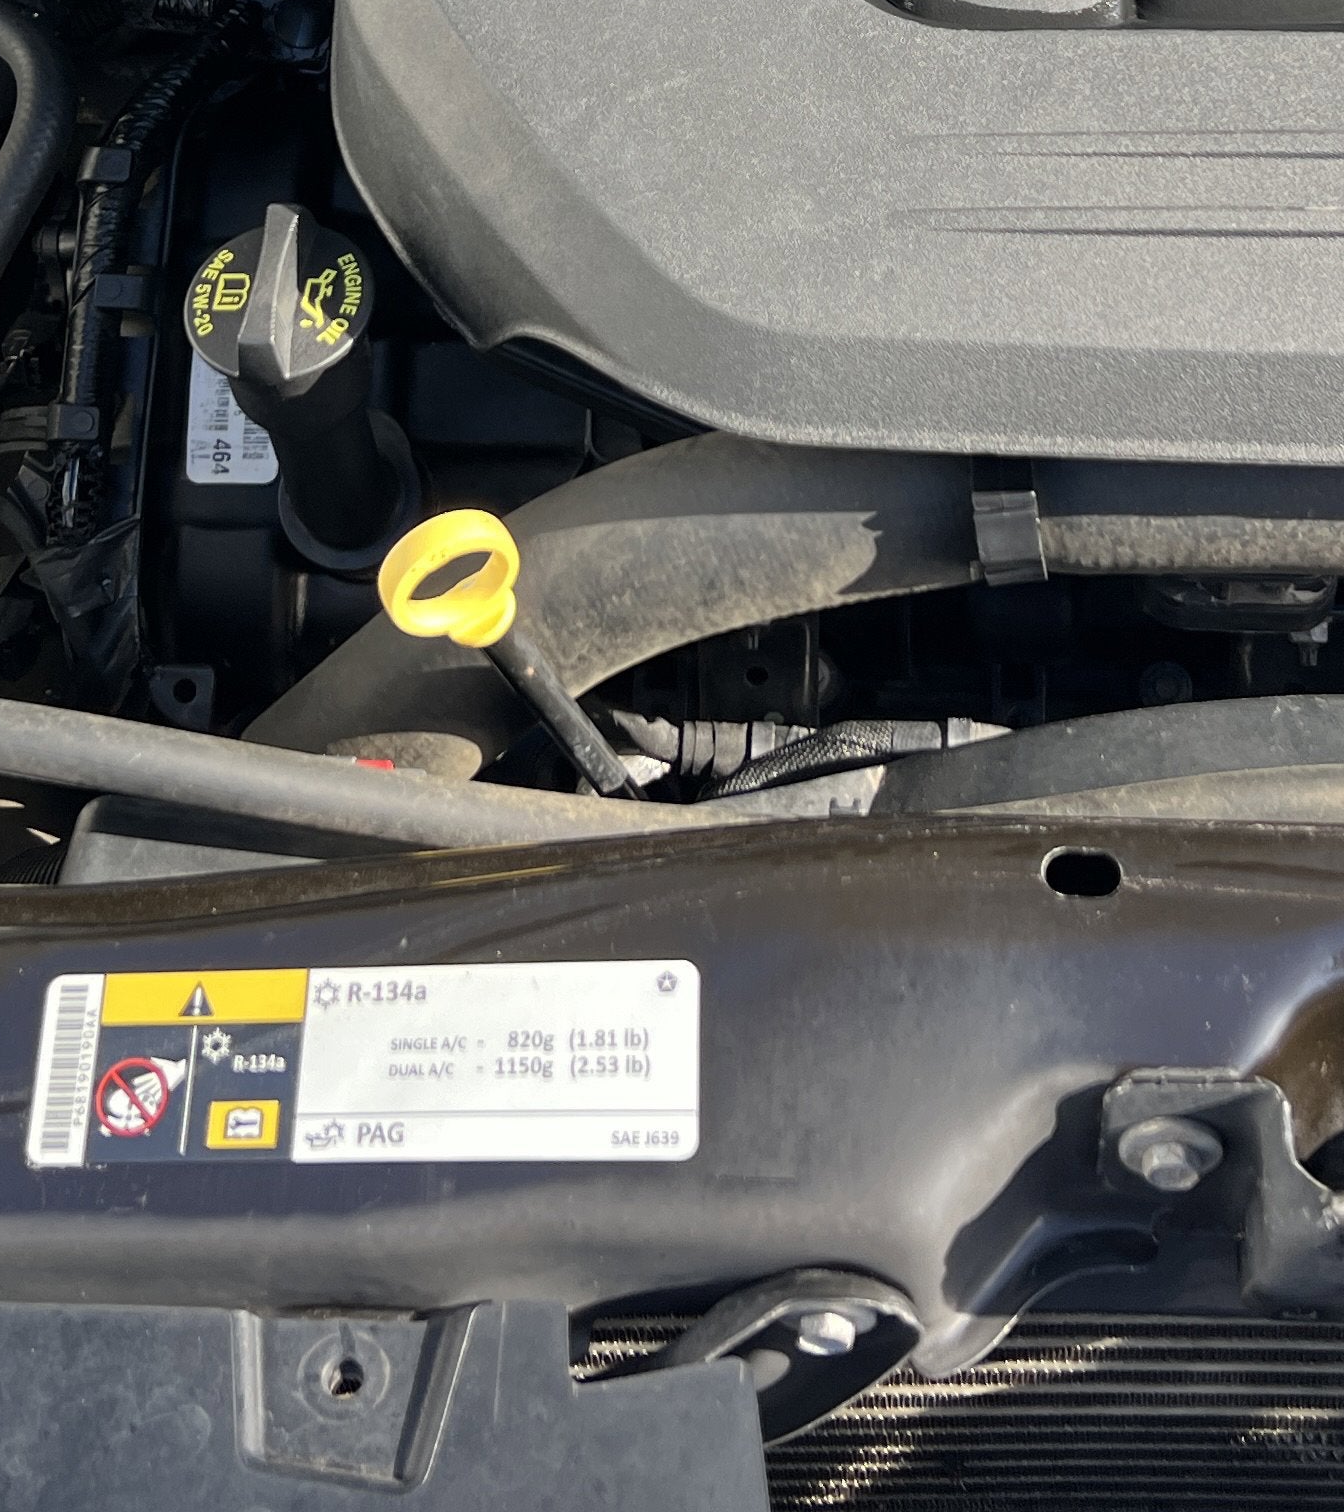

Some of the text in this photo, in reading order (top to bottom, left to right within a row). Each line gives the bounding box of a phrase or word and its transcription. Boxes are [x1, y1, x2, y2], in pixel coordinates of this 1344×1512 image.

[192, 249, 234, 337] SAE 5W-20
[316, 253, 362, 345] ENGINE OIL
[212, 439, 232, 475] 464
[347, 980, 428, 1004] R-134a
[390, 1037, 438, 1052] SINGLE
[441, 1035, 467, 1051] A/C
[507, 1030, 554, 1053] 820g
[568, 1028, 617, 1051] (1.81
[624, 1026, 649, 1051] lb)
[233, 1054, 287, 1073] R-134a
[388, 1064, 426, 1079] DUAL
[428, 1062, 454, 1078] A/C
[494, 1057, 554, 1080] 1150g
[570, 1055, 619, 1079] (2.53
[625, 1054, 651, 1079] lb)
[357, 1121, 680, 1146] PAG SAE J639
